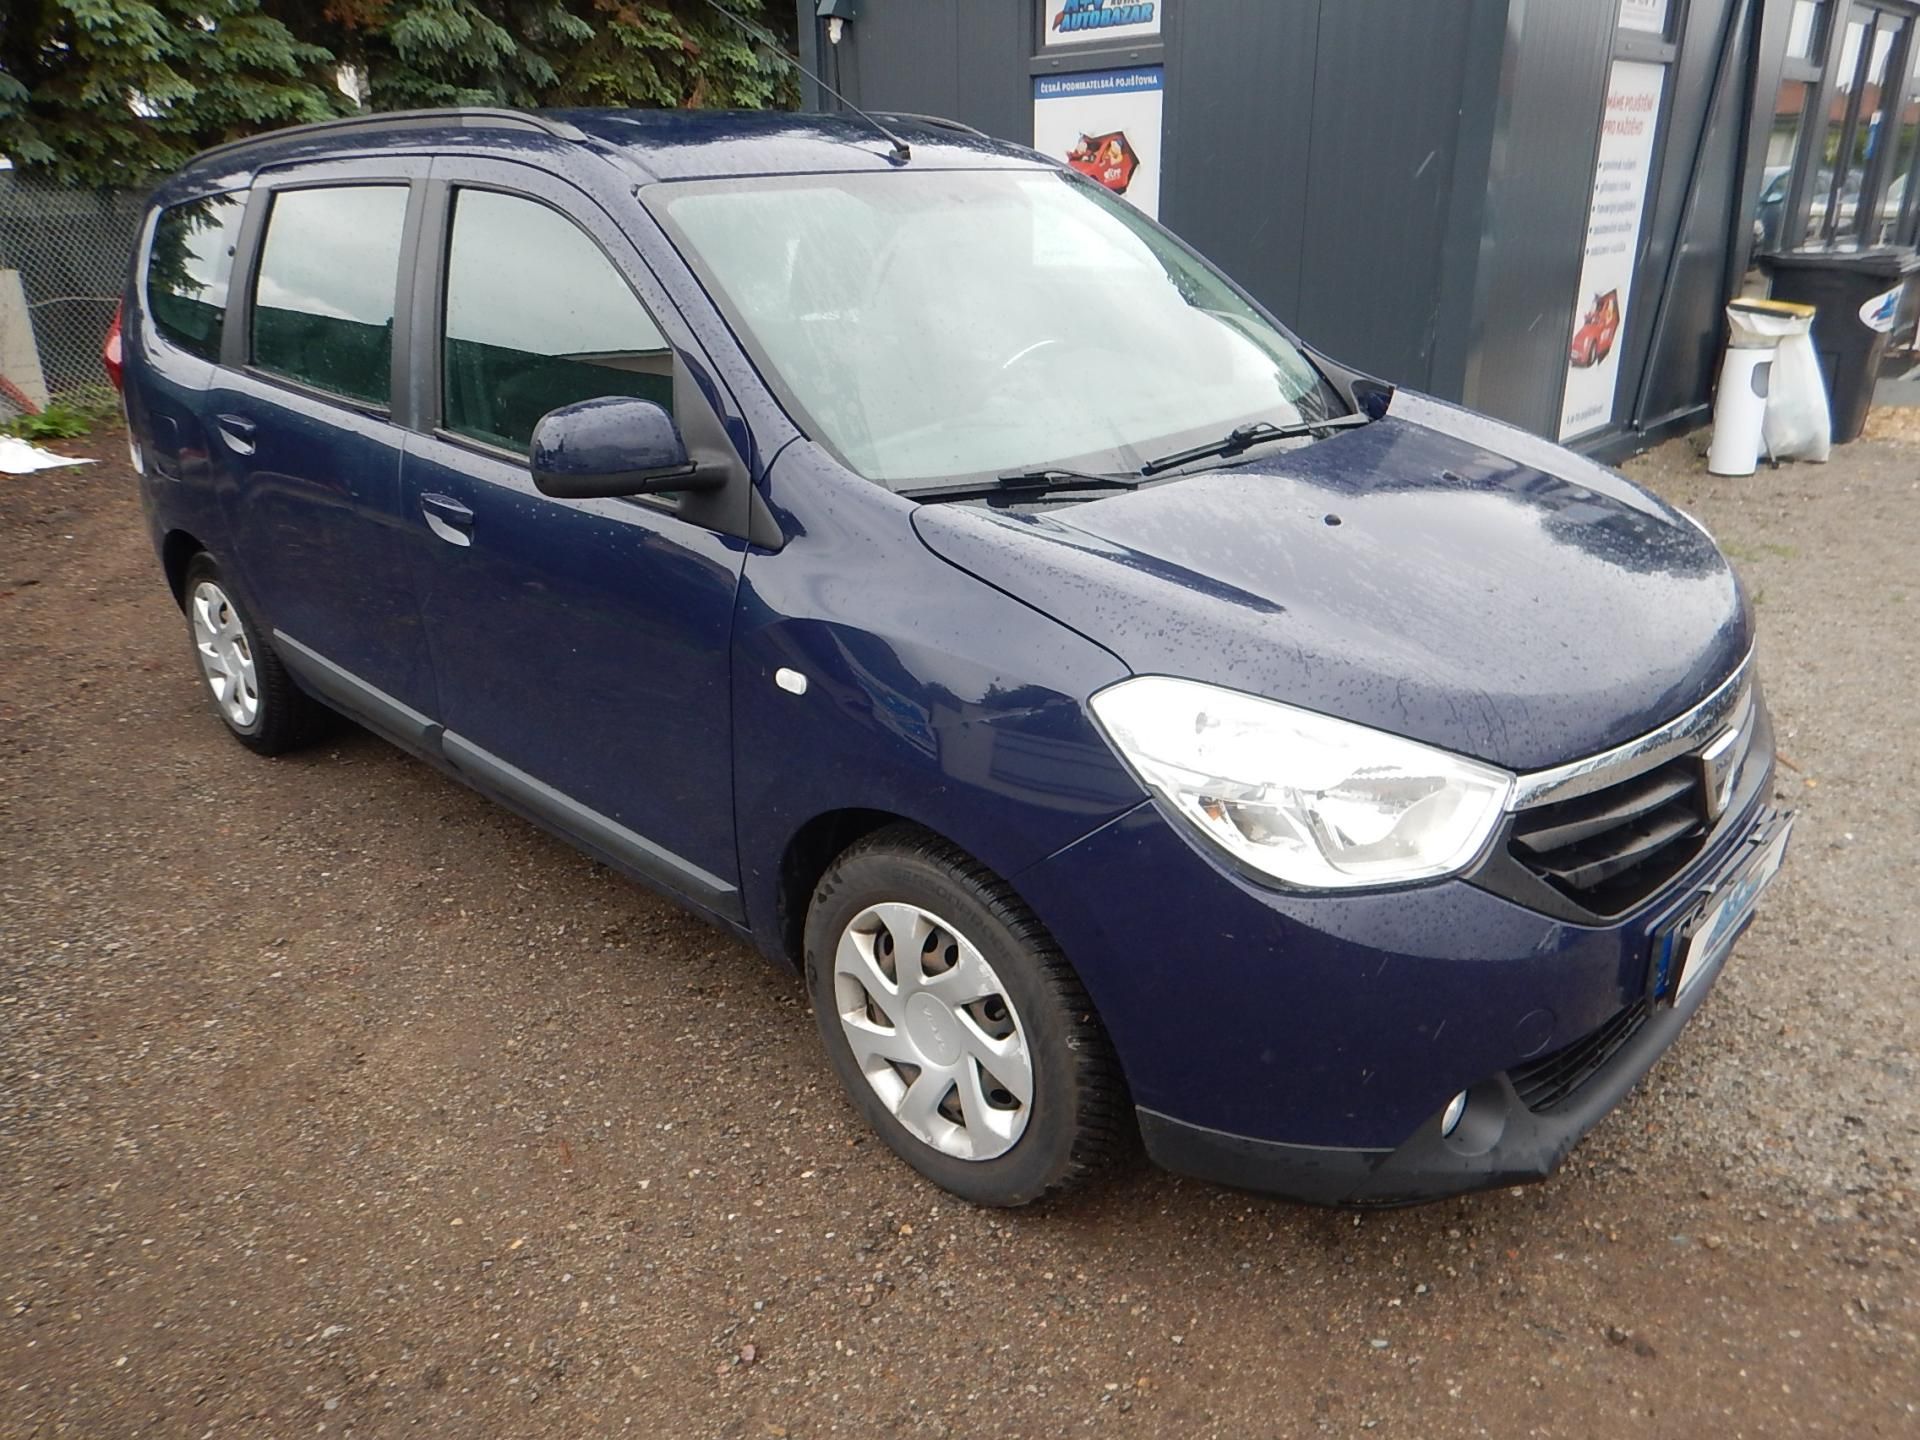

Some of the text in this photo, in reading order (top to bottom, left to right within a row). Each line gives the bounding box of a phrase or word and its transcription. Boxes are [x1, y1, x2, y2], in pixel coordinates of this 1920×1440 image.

[1059, 3, 1154, 32] AUTOBAZAR
[1040, 75, 1158, 93] ČESKÁ PODNIKATELSKÁ POJIŠŤOVNA
